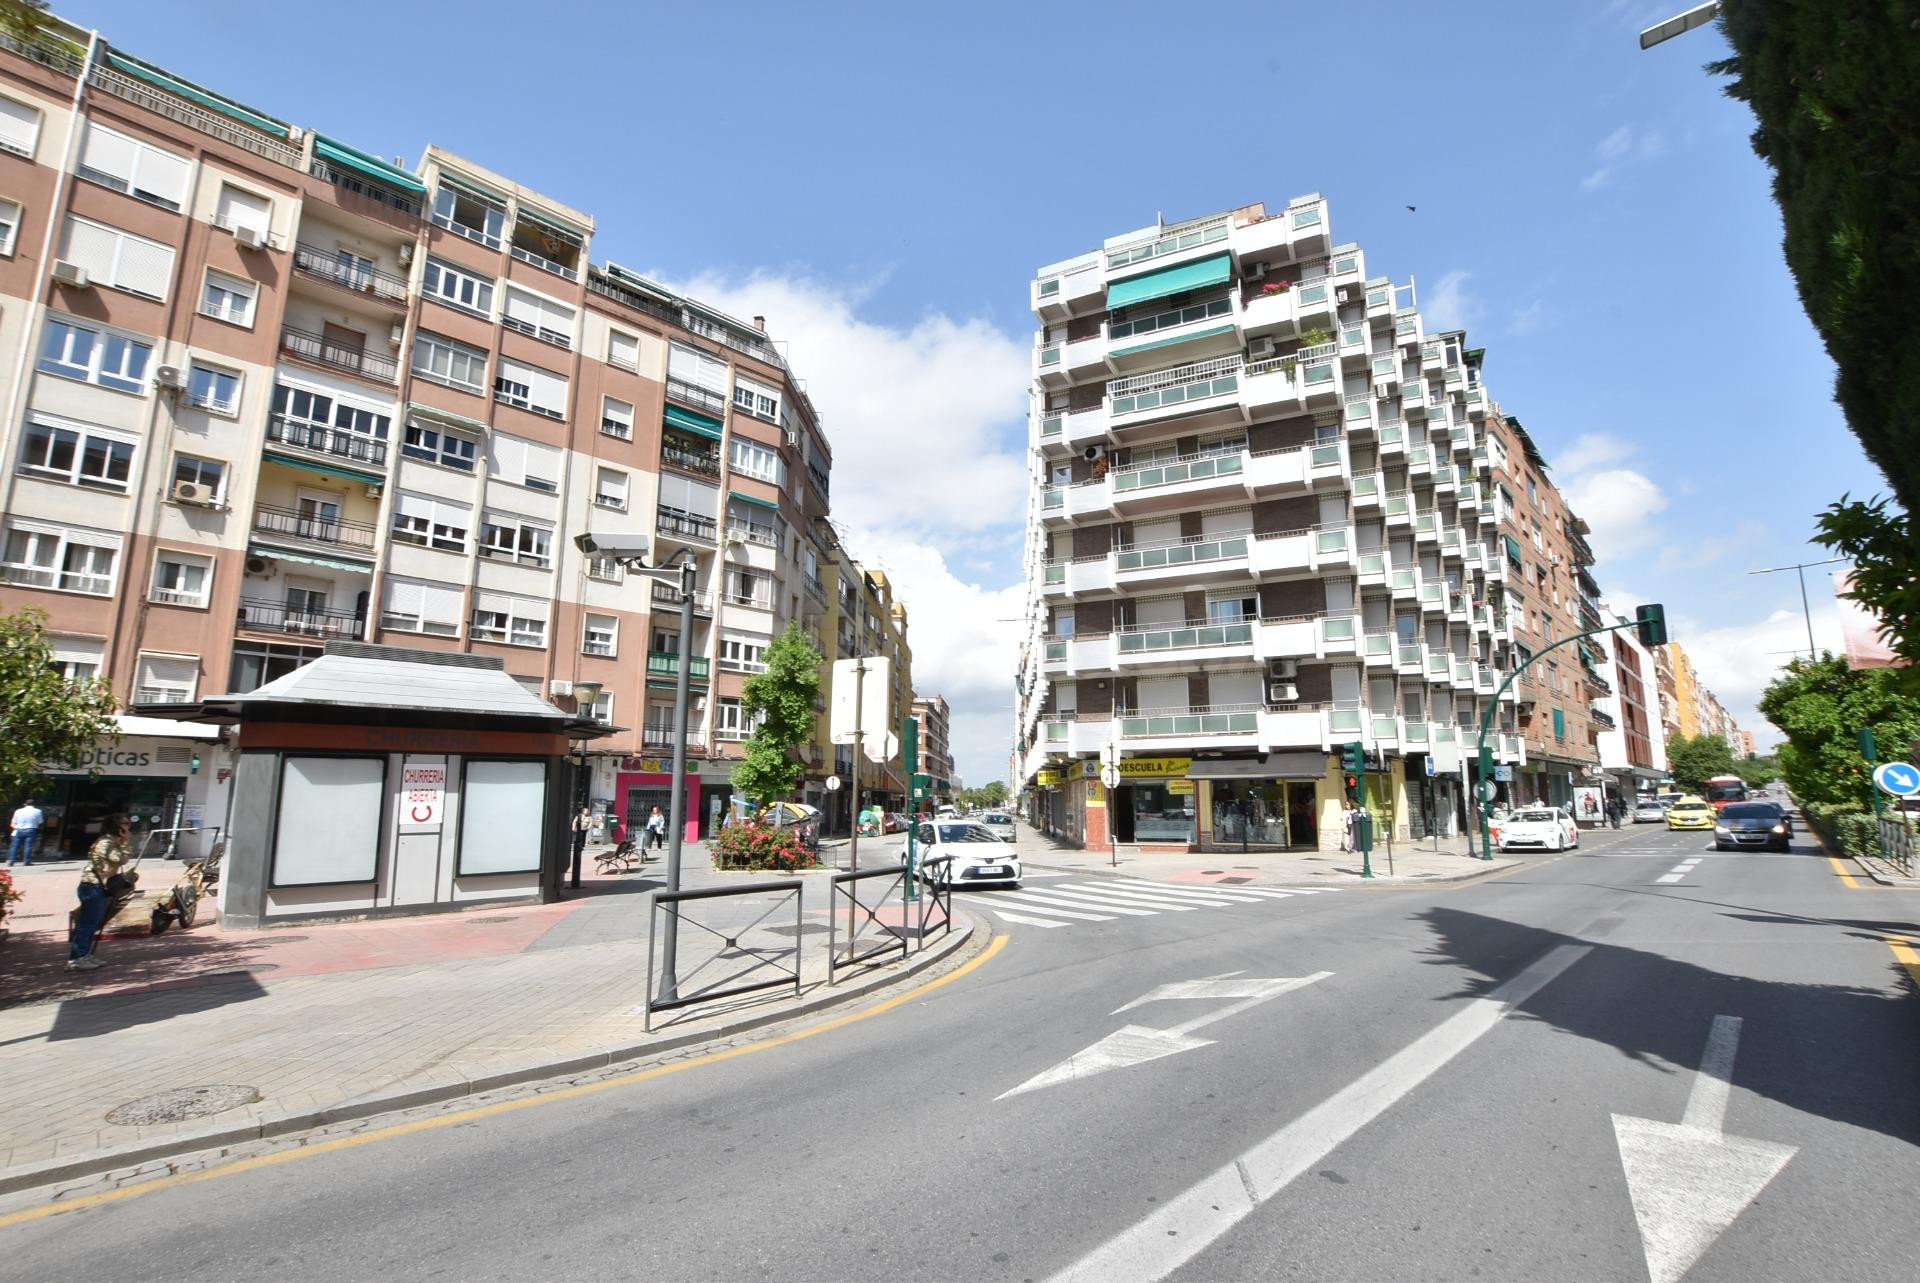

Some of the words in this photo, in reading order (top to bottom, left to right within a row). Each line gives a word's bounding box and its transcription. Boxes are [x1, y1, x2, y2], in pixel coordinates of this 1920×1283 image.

[74, 746, 150, 769] pticas
[1118, 762, 1163, 773] OESCUELA
[404, 769, 444, 783] CHURRERIA
[408, 788, 437, 802] ABIERTA
